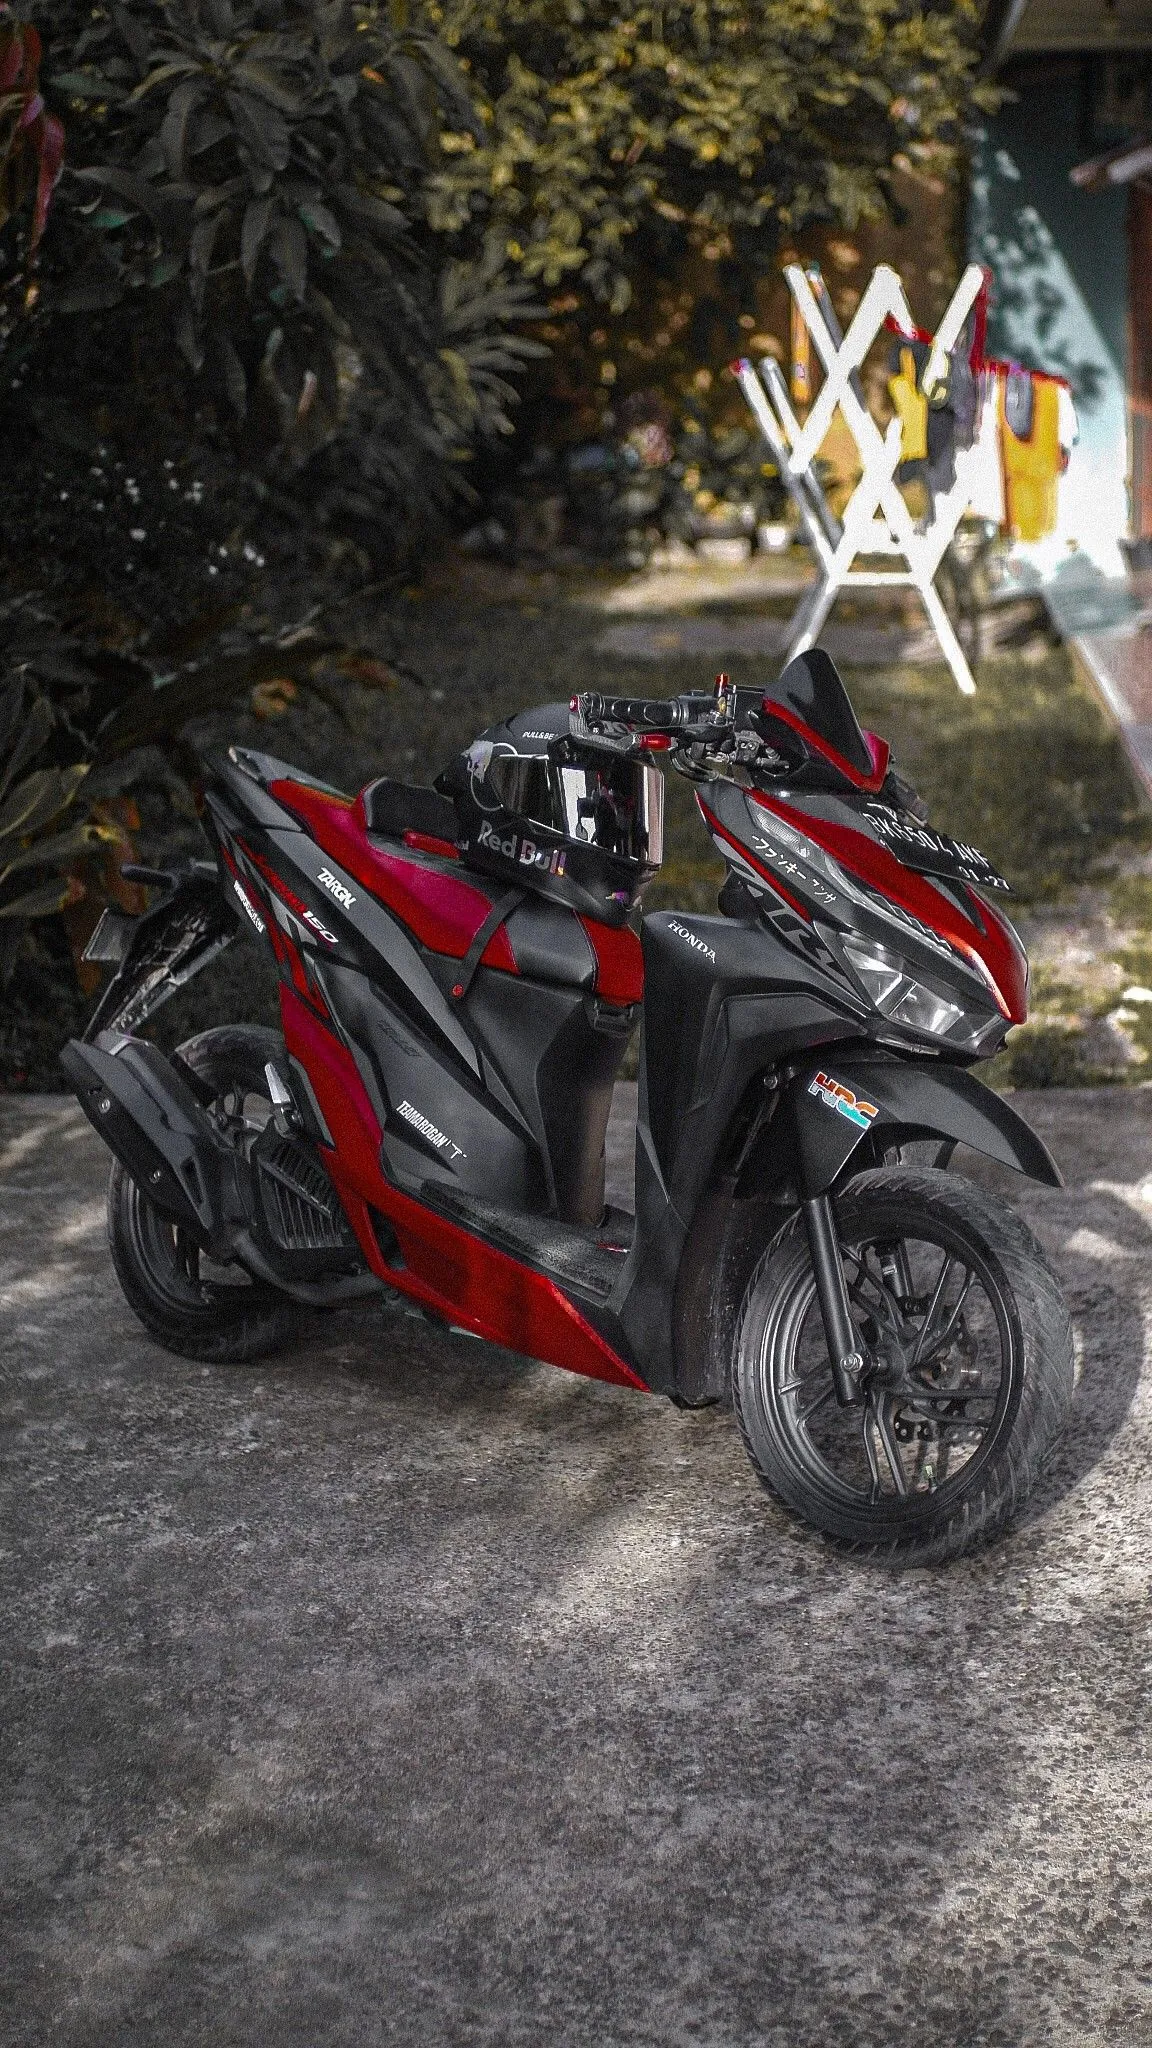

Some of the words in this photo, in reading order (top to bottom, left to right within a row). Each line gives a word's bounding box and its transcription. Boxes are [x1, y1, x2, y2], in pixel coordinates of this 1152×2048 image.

[522, 731, 558, 740] PULL&BE
[477, 820, 518, 859] Red
[519, 839, 567, 876] Bull
[303, 911, 339, 943] 150
[667, 919, 716, 964] HONDA
[808, 1071, 880, 1130] HRC
